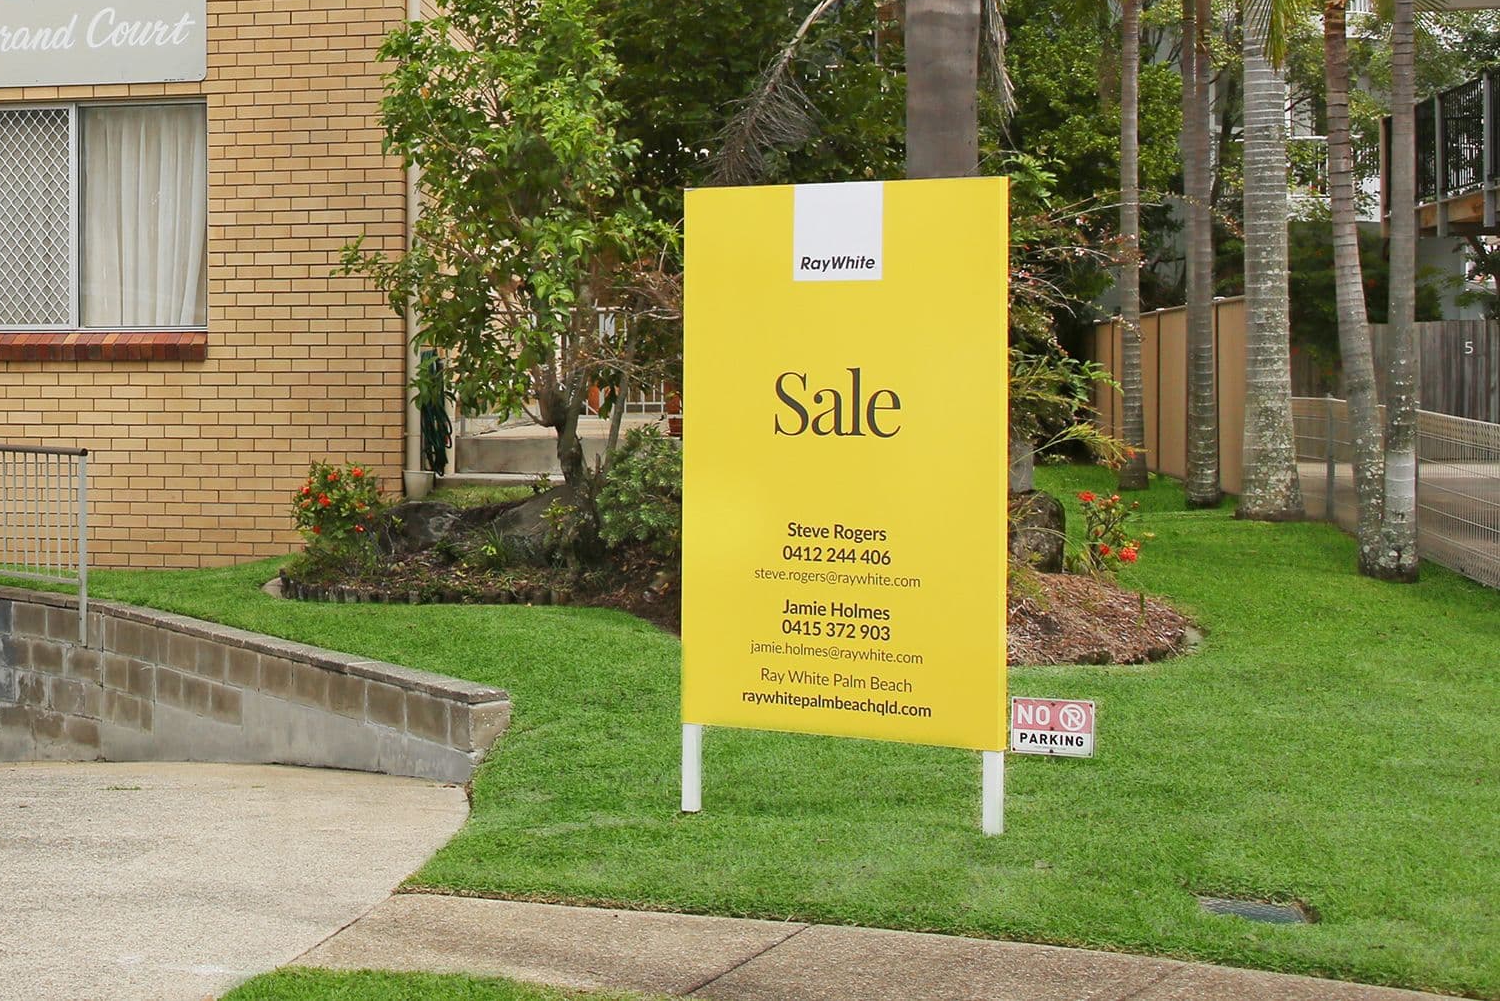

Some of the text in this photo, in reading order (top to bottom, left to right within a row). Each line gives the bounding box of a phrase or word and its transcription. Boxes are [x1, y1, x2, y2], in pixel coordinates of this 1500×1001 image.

[86, 6, 196, 48] Court
[1464, 340, 1474, 355] 5
[773, 366, 902, 439] Sale
[787, 521, 887, 544] Steve Rogers
[782, 544, 892, 566] 0412 244 406
[754, 566, 921, 588] steve.rogers@raywhite.com
[781, 598, 891, 621] Jamie Holmes
[781, 618, 891, 642] 0415 372 903
[750, 640, 924, 665] jamie.holmes@raywhite.com
[760, 667, 913, 693] Ray White Palm Beach
[742, 690, 932, 718] raywhitepalmbeachqld.com
[1017, 704, 1051, 726] NO
[1019, 732, 1084, 747] PARKING
